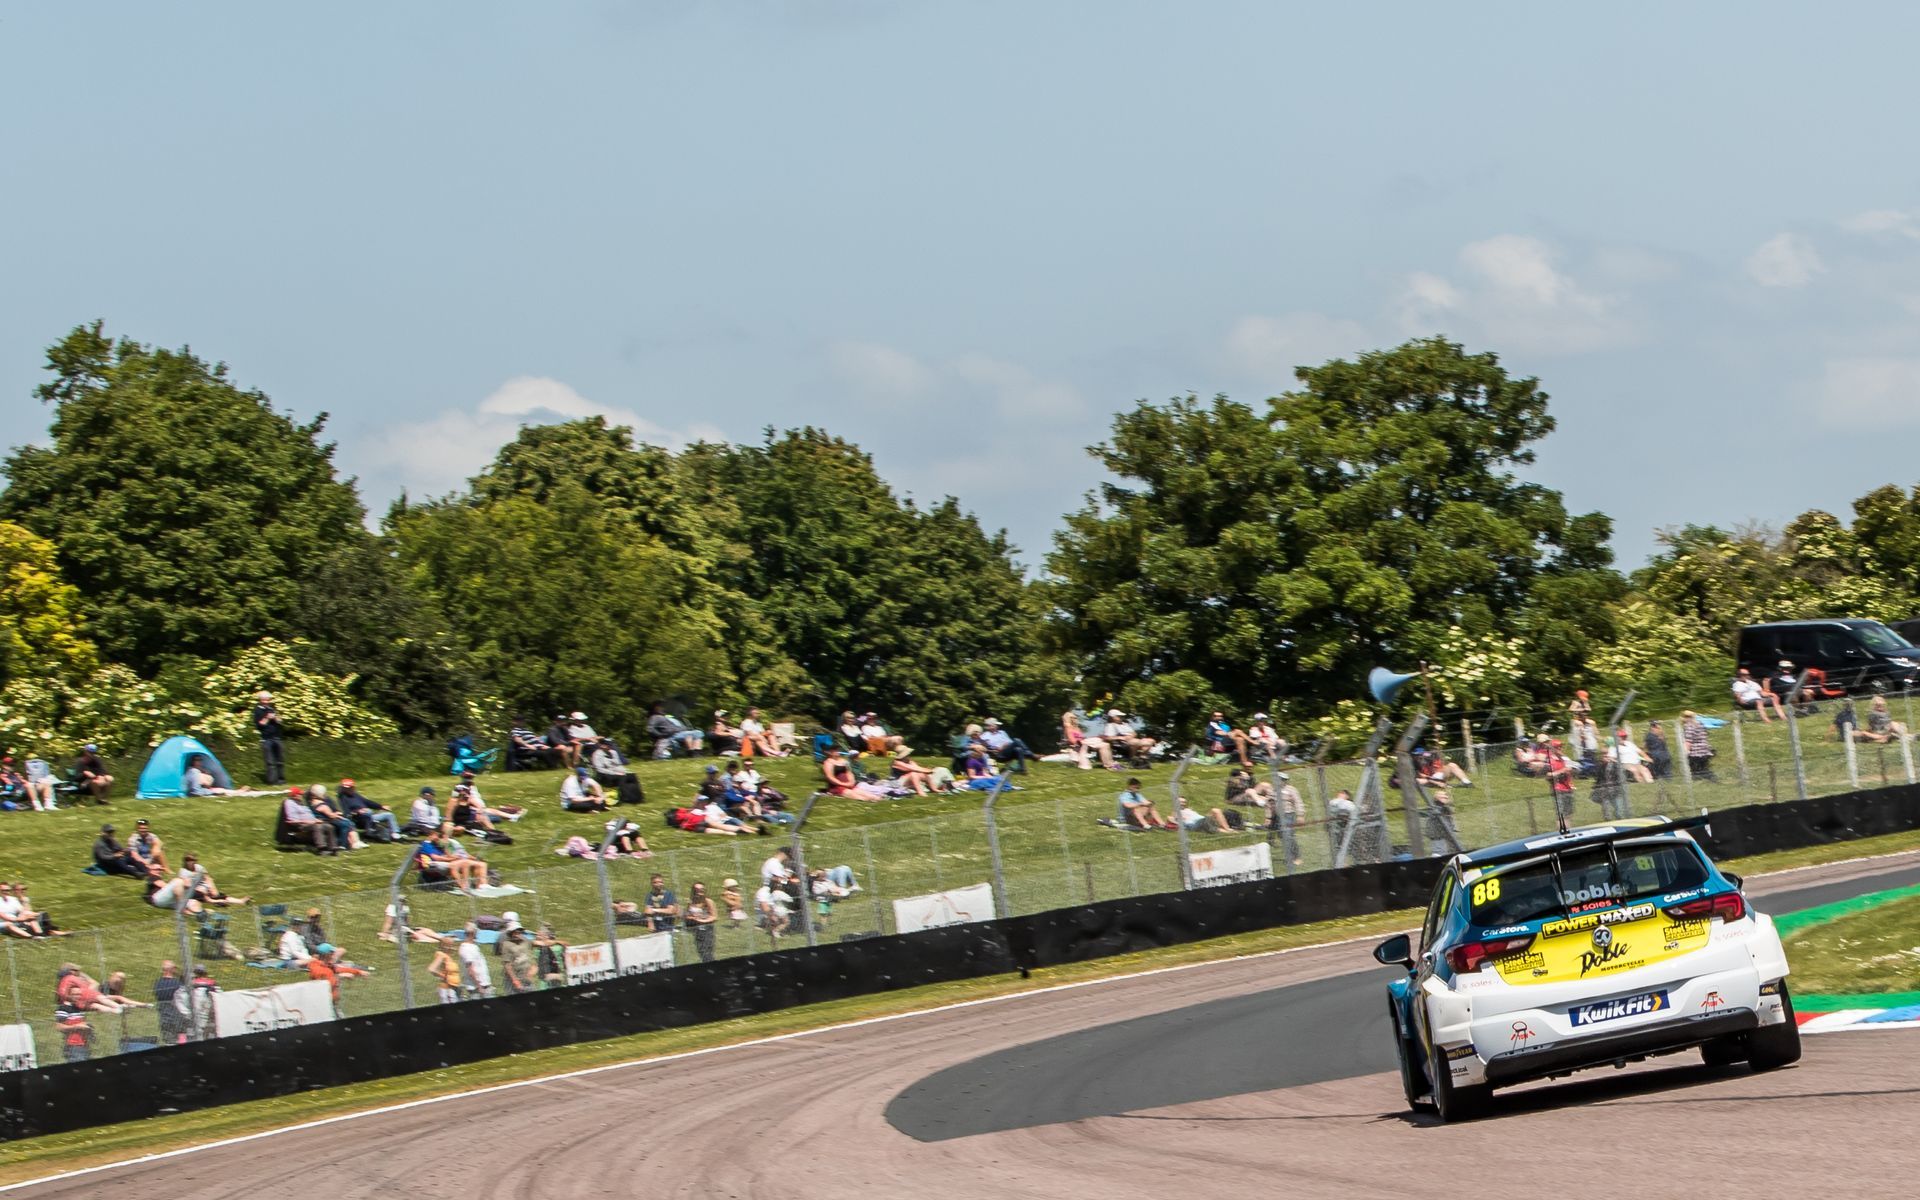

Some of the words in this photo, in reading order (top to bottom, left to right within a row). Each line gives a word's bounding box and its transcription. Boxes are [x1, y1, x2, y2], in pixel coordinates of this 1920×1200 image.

[1473, 878, 1501, 906] 88
[1559, 882, 1624, 906] Doble
[1545, 916, 1599, 935] POWER
[1685, 920, 1703, 933] Seal
[1504, 956, 1526, 968] Steel
[1525, 952, 1543, 964] Seal
[1574, 942, 1632, 978] Doble
[1600, 959, 1645, 972] MOTORCYCLES
